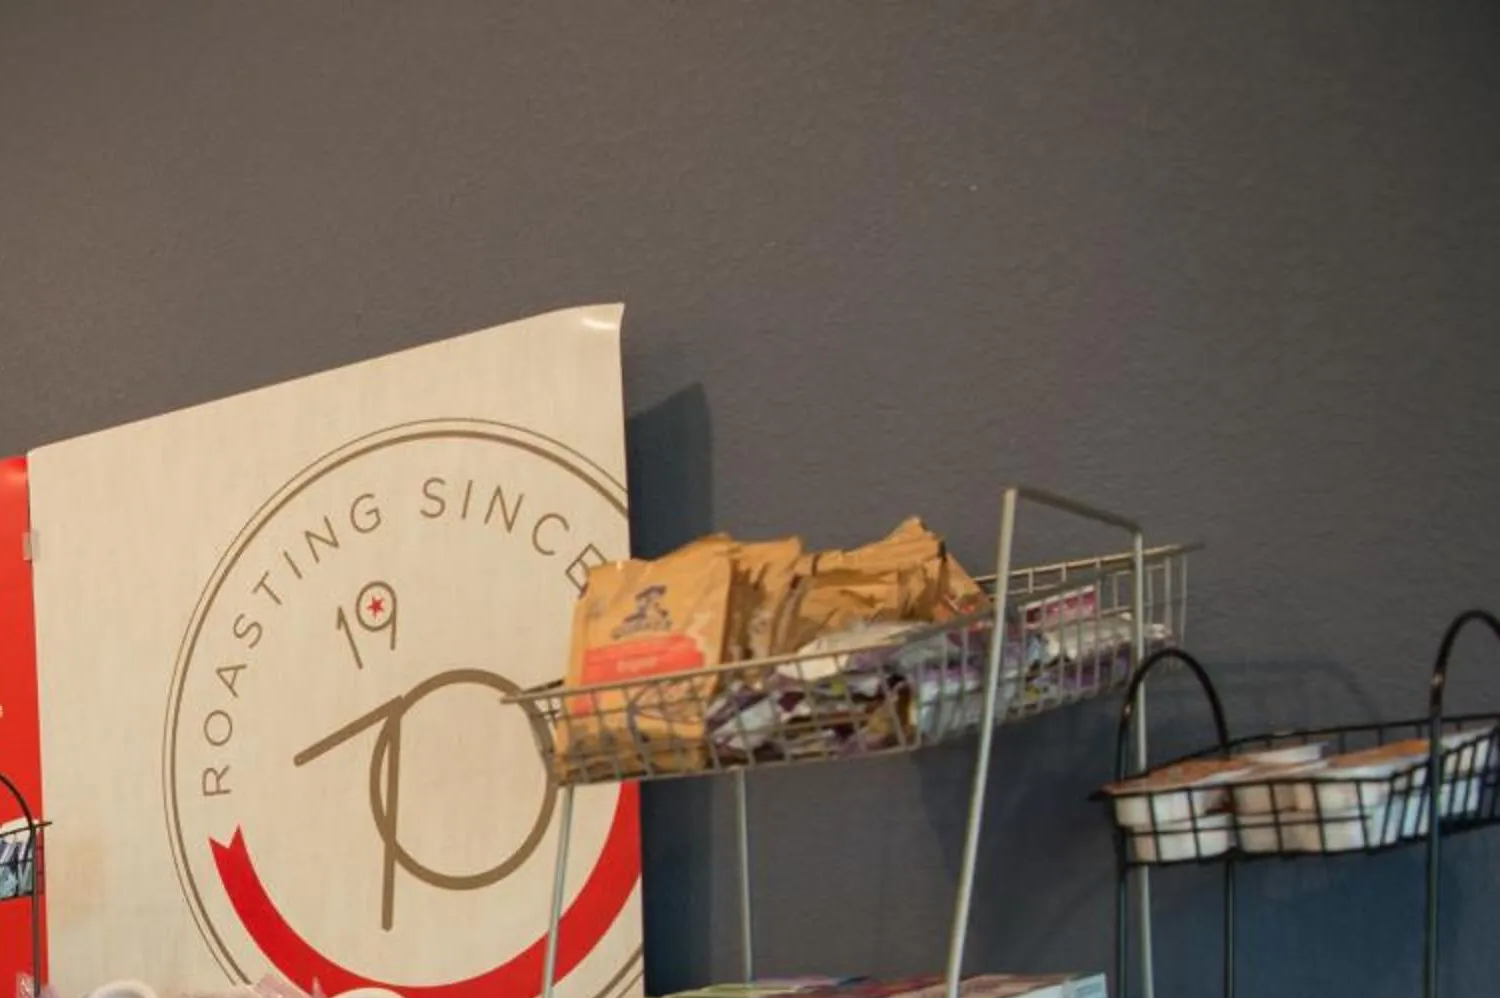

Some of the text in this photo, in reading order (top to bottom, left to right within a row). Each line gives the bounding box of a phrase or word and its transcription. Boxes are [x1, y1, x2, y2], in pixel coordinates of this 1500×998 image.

[202, 477, 608, 798] ROASTING SINCE
[336, 581, 398, 669] 19
